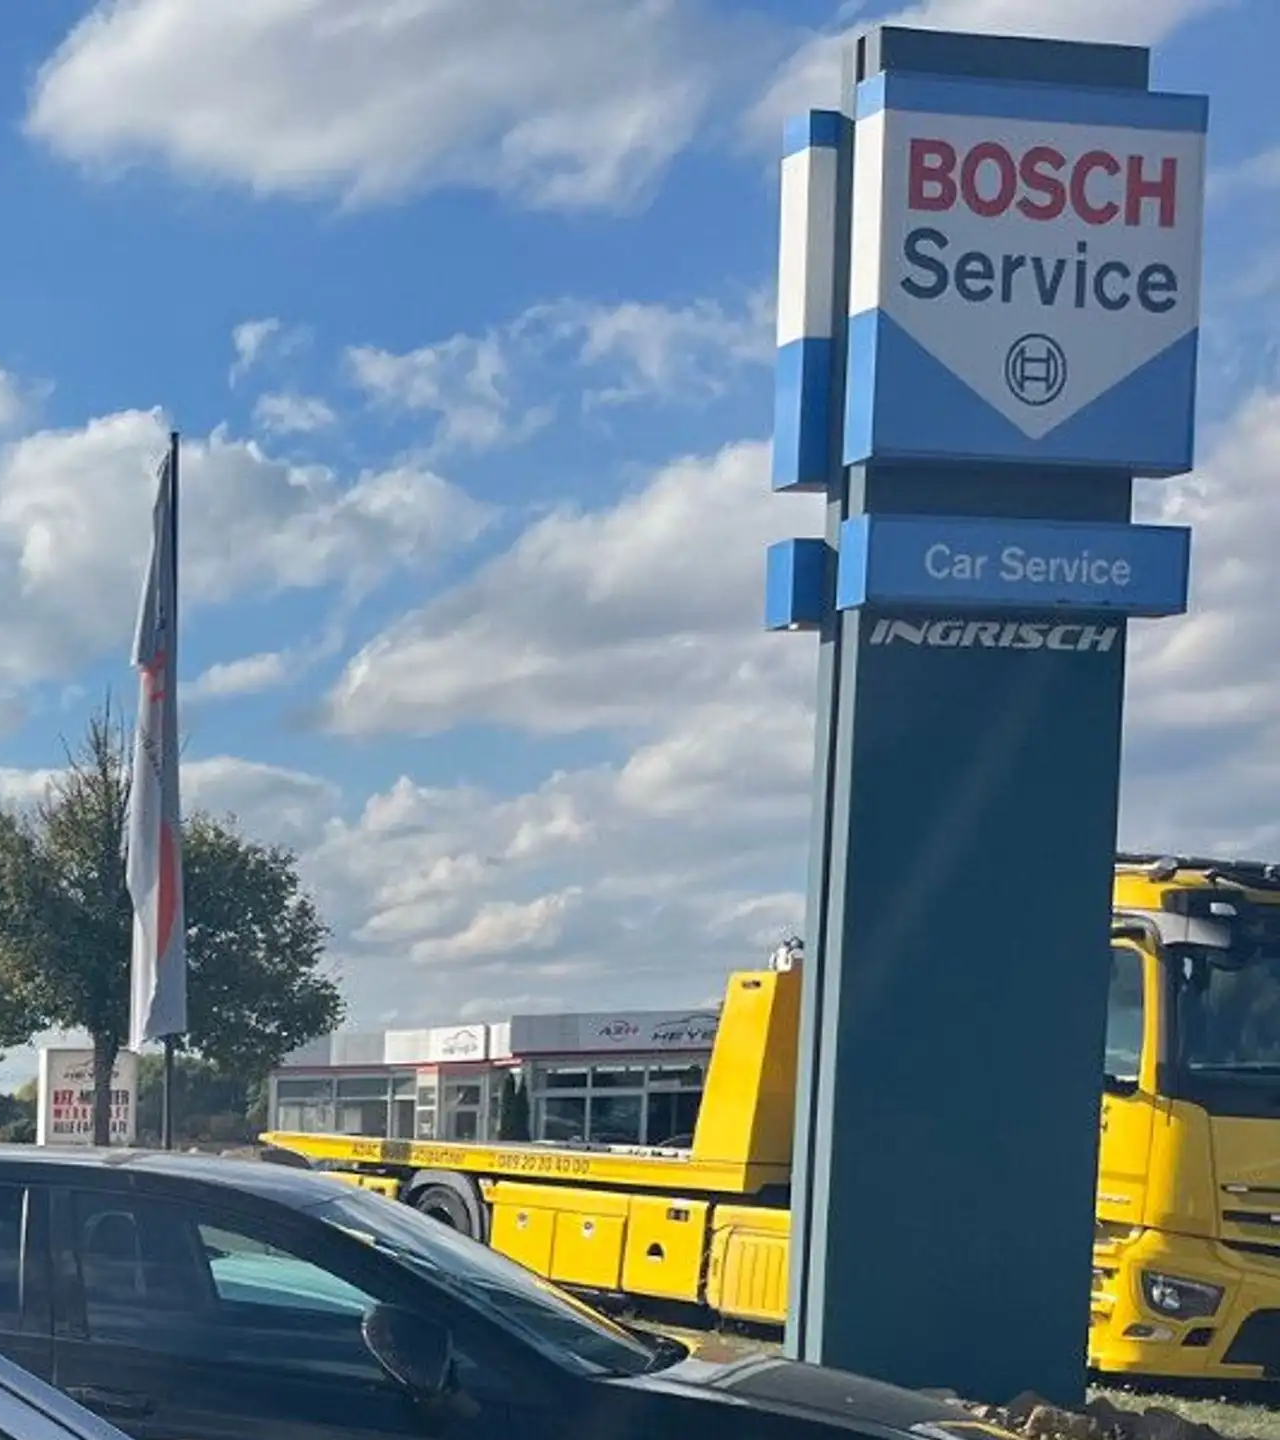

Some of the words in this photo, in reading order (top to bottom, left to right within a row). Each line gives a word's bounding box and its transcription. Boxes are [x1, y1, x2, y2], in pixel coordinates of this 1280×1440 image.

[908, 138, 1178, 228] BOSCH
[900, 227, 1178, 313] Service
[925, 545, 989, 580] Car
[1000, 547, 1132, 587] Service
[870, 619, 1119, 652] INGRISCH
